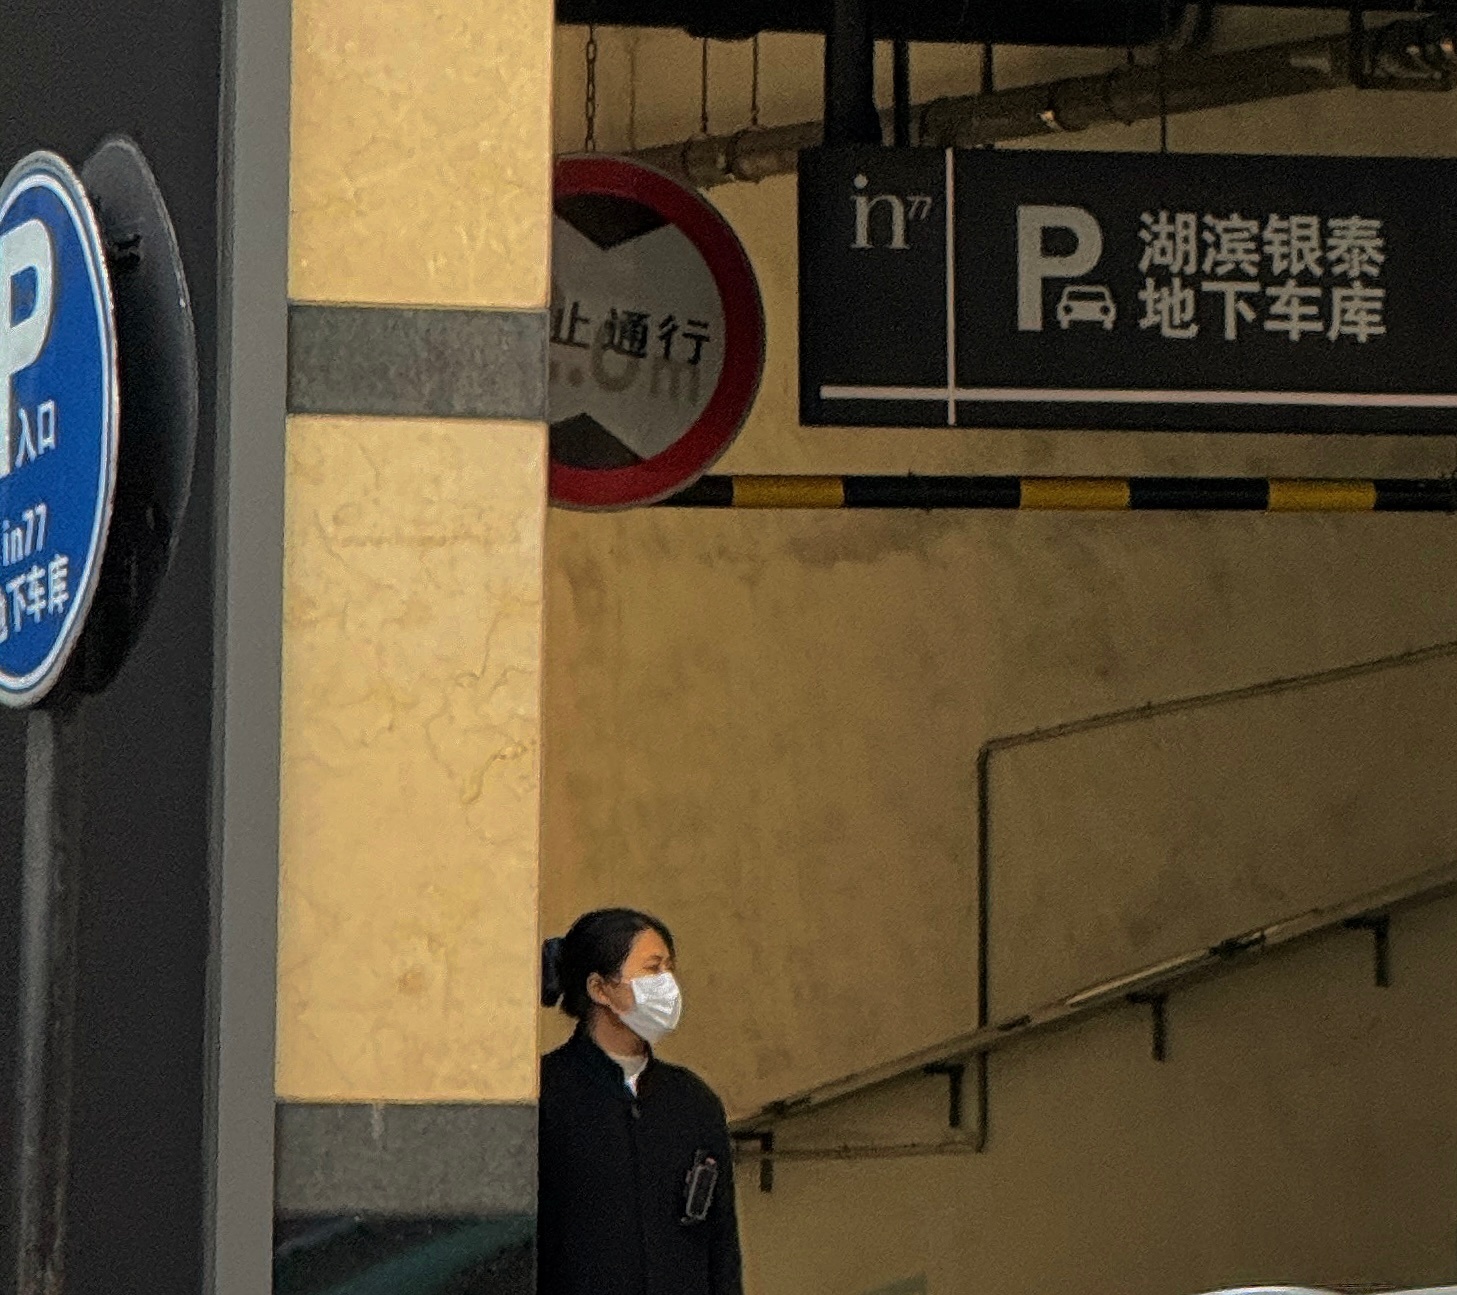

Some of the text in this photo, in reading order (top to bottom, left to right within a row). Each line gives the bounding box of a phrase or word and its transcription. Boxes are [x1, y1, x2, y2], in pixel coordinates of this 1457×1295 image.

[1016, 204, 1103, 331] P
[1138, 208, 1386, 277] 湖滨银泰
[1138, 278, 1388, 343] 地下车库
[0, 218, 54, 478] P
[15, 399, 56, 468] 入口
